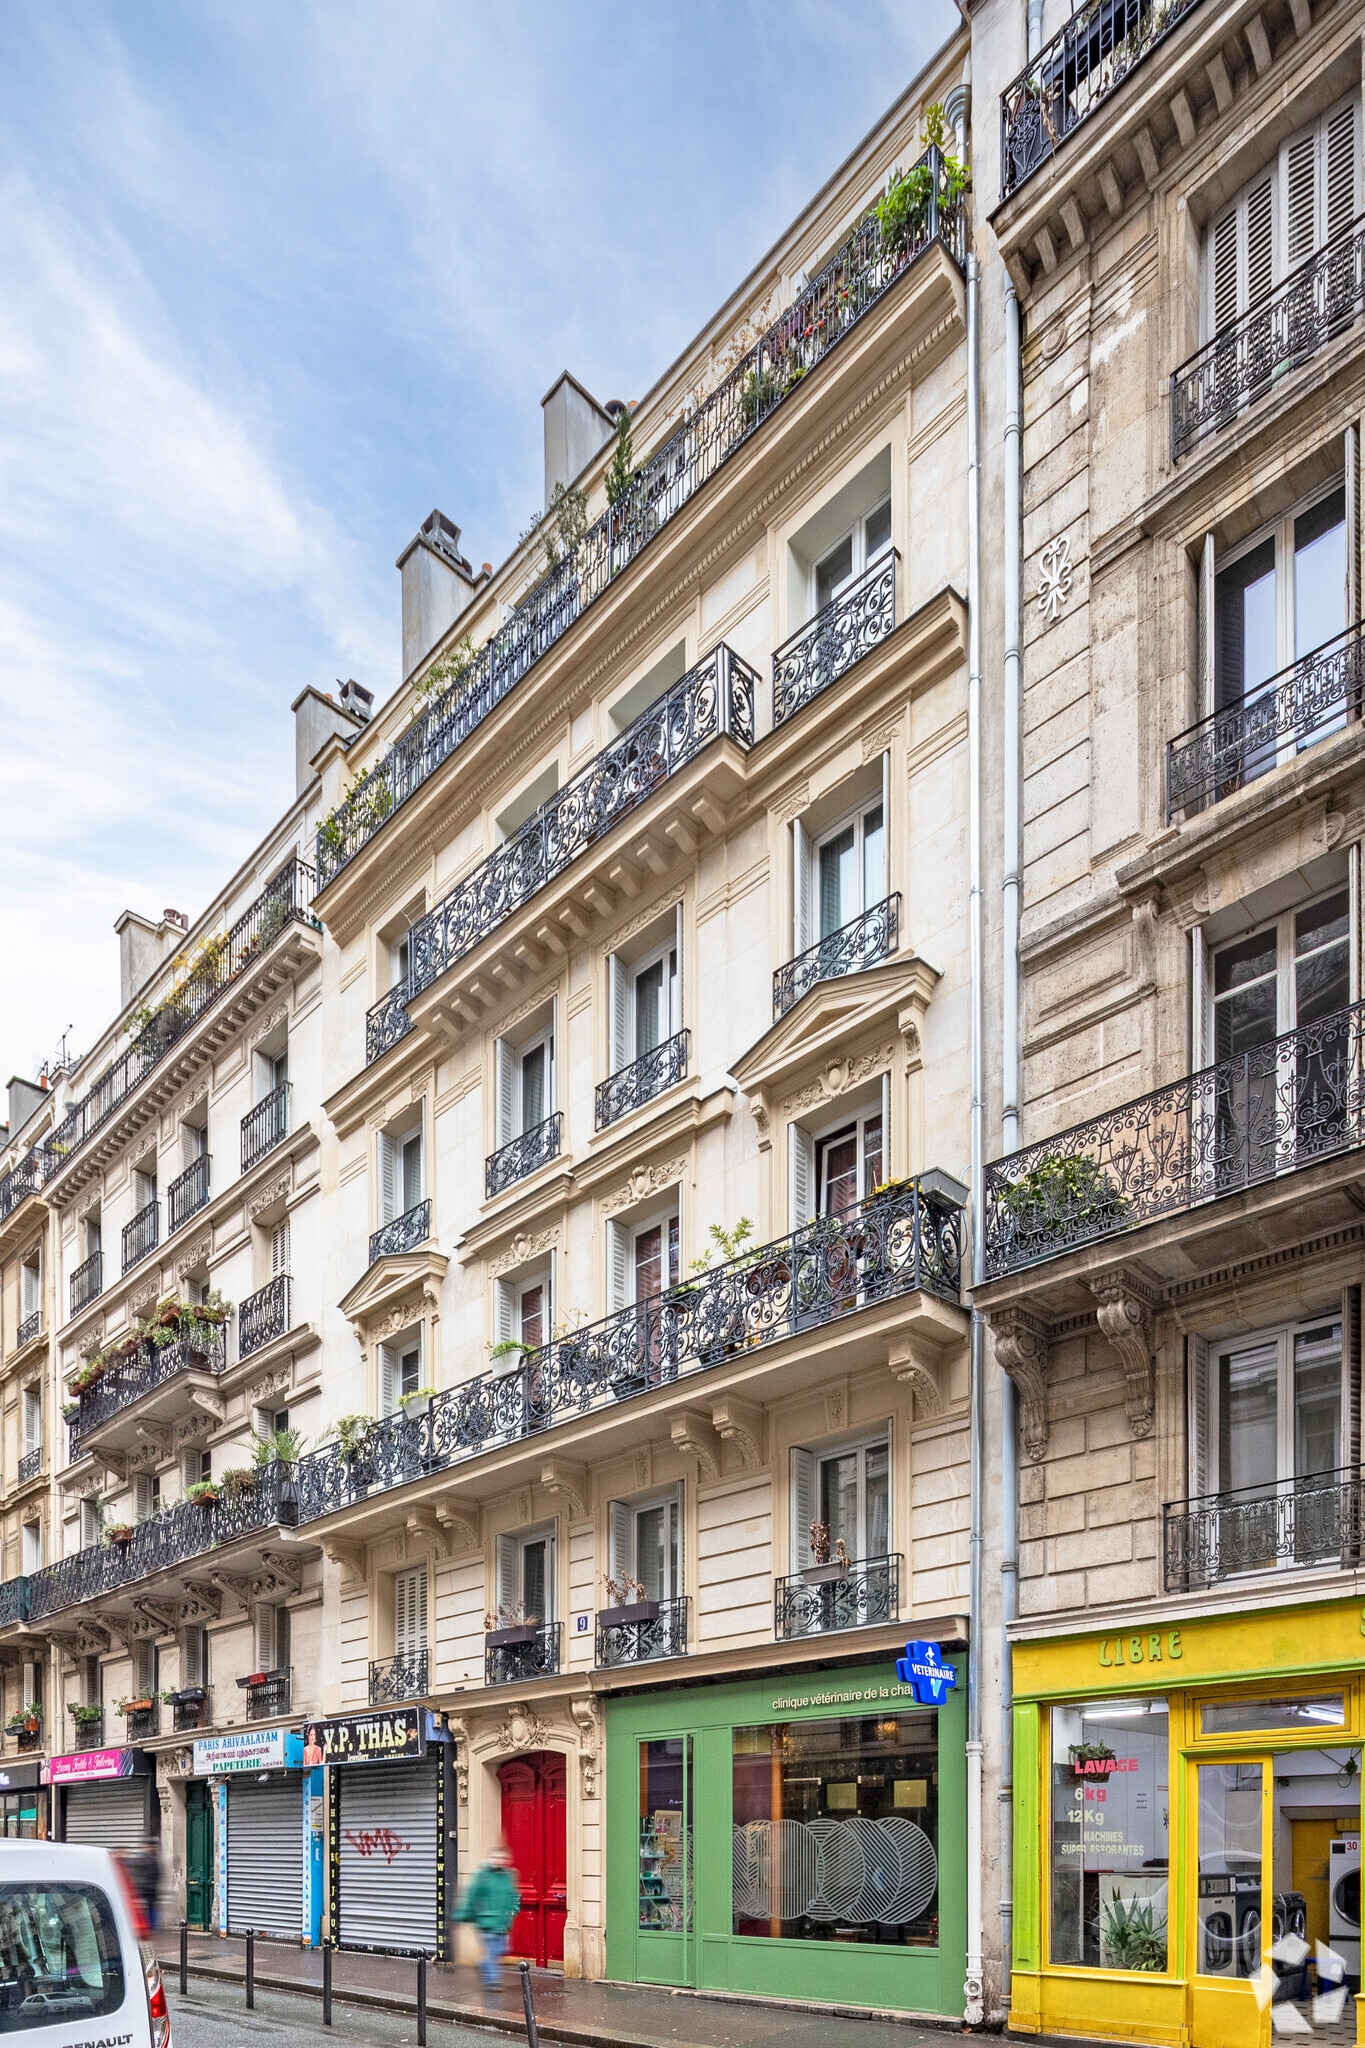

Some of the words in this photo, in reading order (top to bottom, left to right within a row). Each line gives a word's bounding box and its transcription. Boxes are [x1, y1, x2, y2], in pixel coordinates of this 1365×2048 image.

[580, 1617, 586, 1631] 9
[1099, 1631, 1183, 1667] LIBRE
[772, 1695, 809, 1710] clinique
[810, 1689, 862, 1706] vétérinaire
[864, 1685, 877, 1700] de
[879, 1686, 889, 1698] la
[198, 1739, 220, 1751] PARIS
[222, 1731, 278, 1750] ARIVAALAYAM
[356, 1718, 407, 1751] THAS
[212, 1757, 262, 1773] PAPETERIE
[1074, 1759, 1139, 1775] LAVAGE
[1083, 1831, 1124, 1843] MACHINES
[1061, 1844, 1087, 1855] SUPER
[1090, 1844, 1145, 1856] ESSORANTES
[1346, 1841, 1358, 1851] 30
